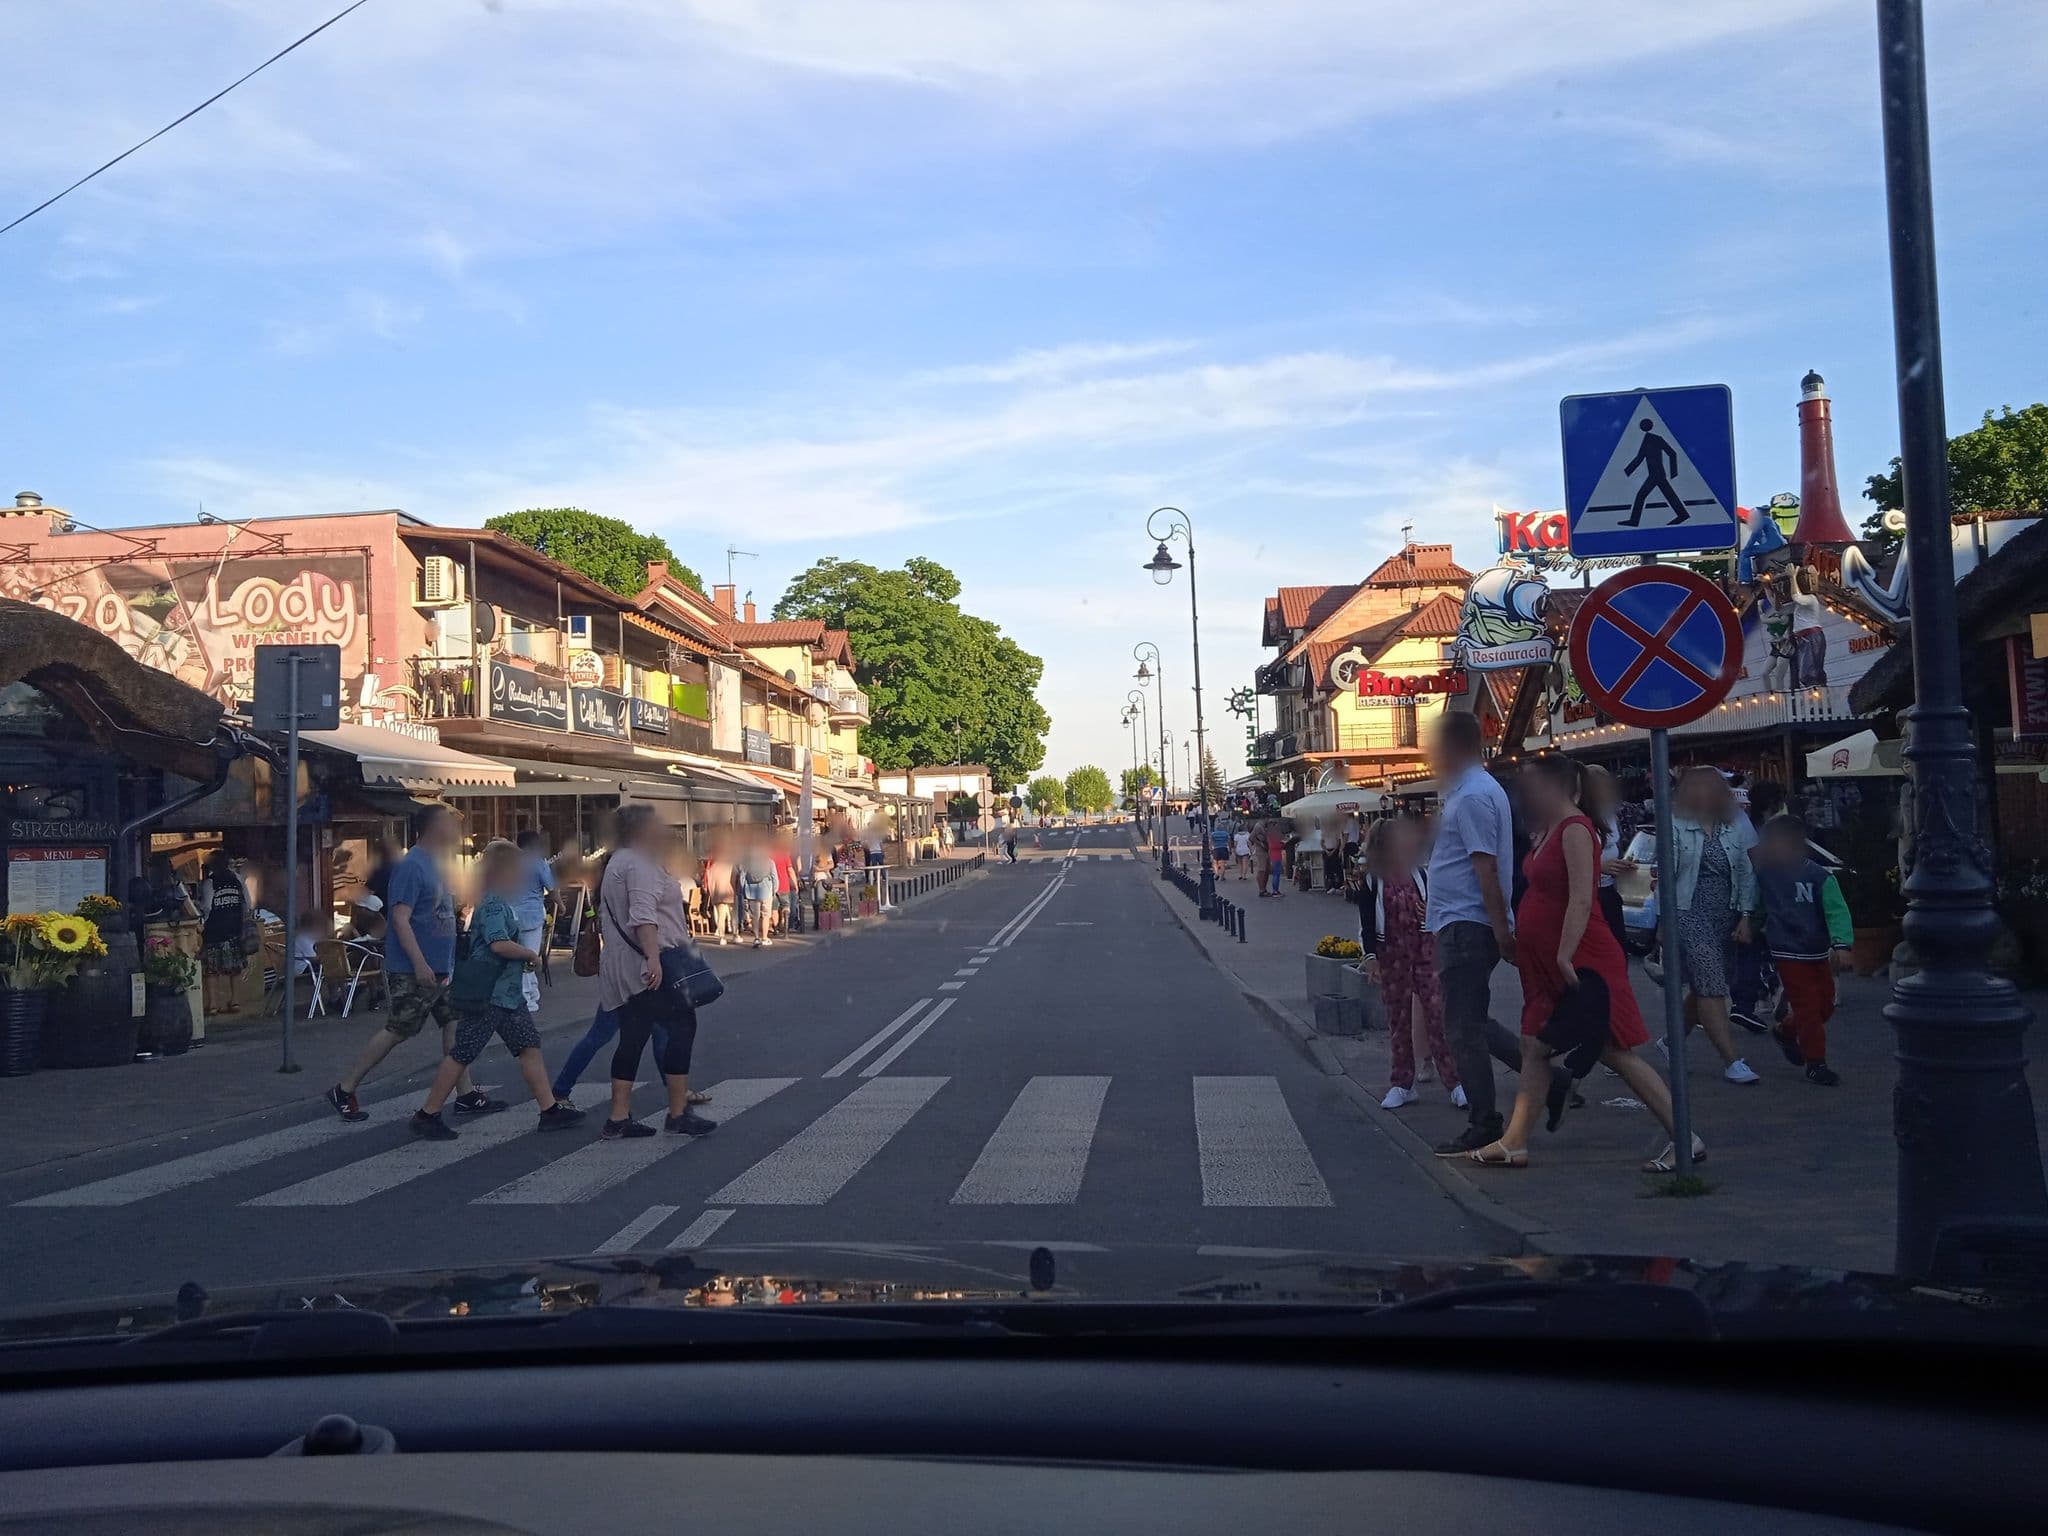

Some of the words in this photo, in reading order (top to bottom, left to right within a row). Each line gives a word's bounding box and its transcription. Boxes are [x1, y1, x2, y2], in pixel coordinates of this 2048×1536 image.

[1501, 511, 1568, 550] Ka
[207, 571, 356, 649] Lody
[1471, 646, 1548, 664] Restauracja
[43, 850, 73, 860] MENU
[1795, 881, 1813, 902] N
